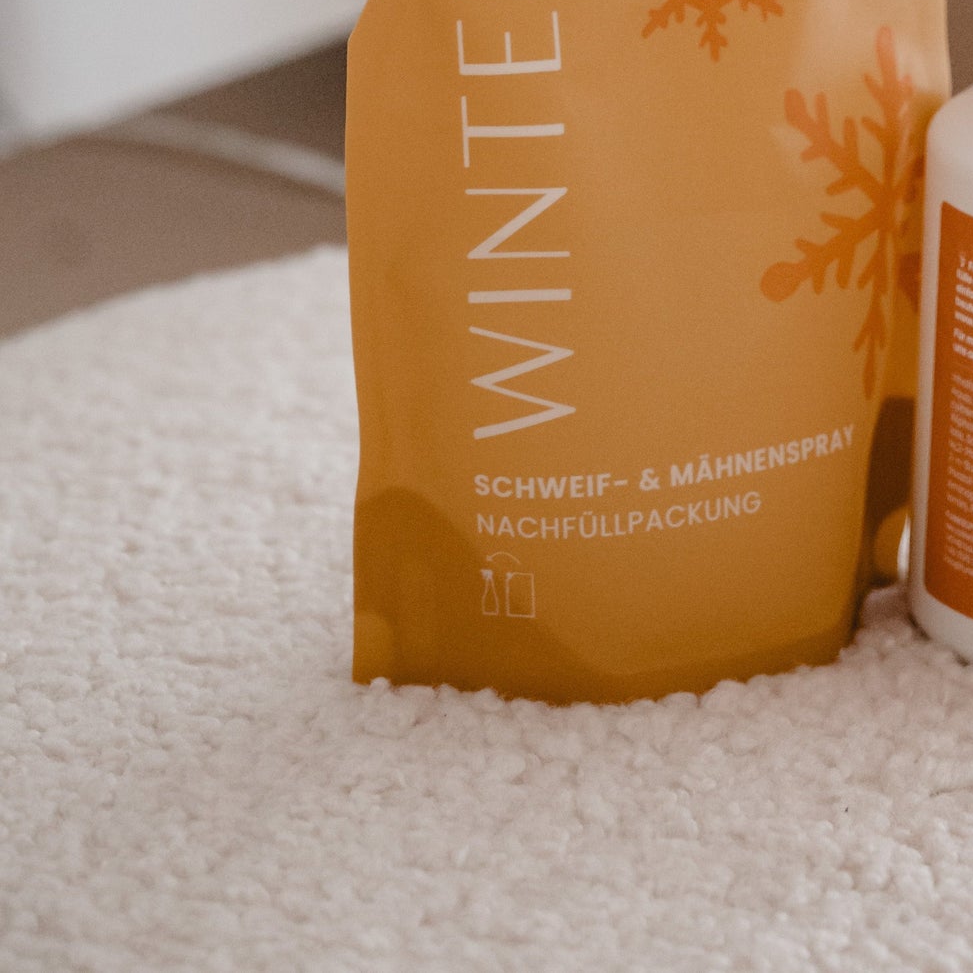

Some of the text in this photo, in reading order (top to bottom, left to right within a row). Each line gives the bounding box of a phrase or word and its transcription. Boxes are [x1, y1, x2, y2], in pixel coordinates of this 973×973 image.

[474, 423, 857, 500] SCHWEIF- & MÄHNENSPRAY
[476, 490, 763, 540] NACHFÜLLPACKUNG
